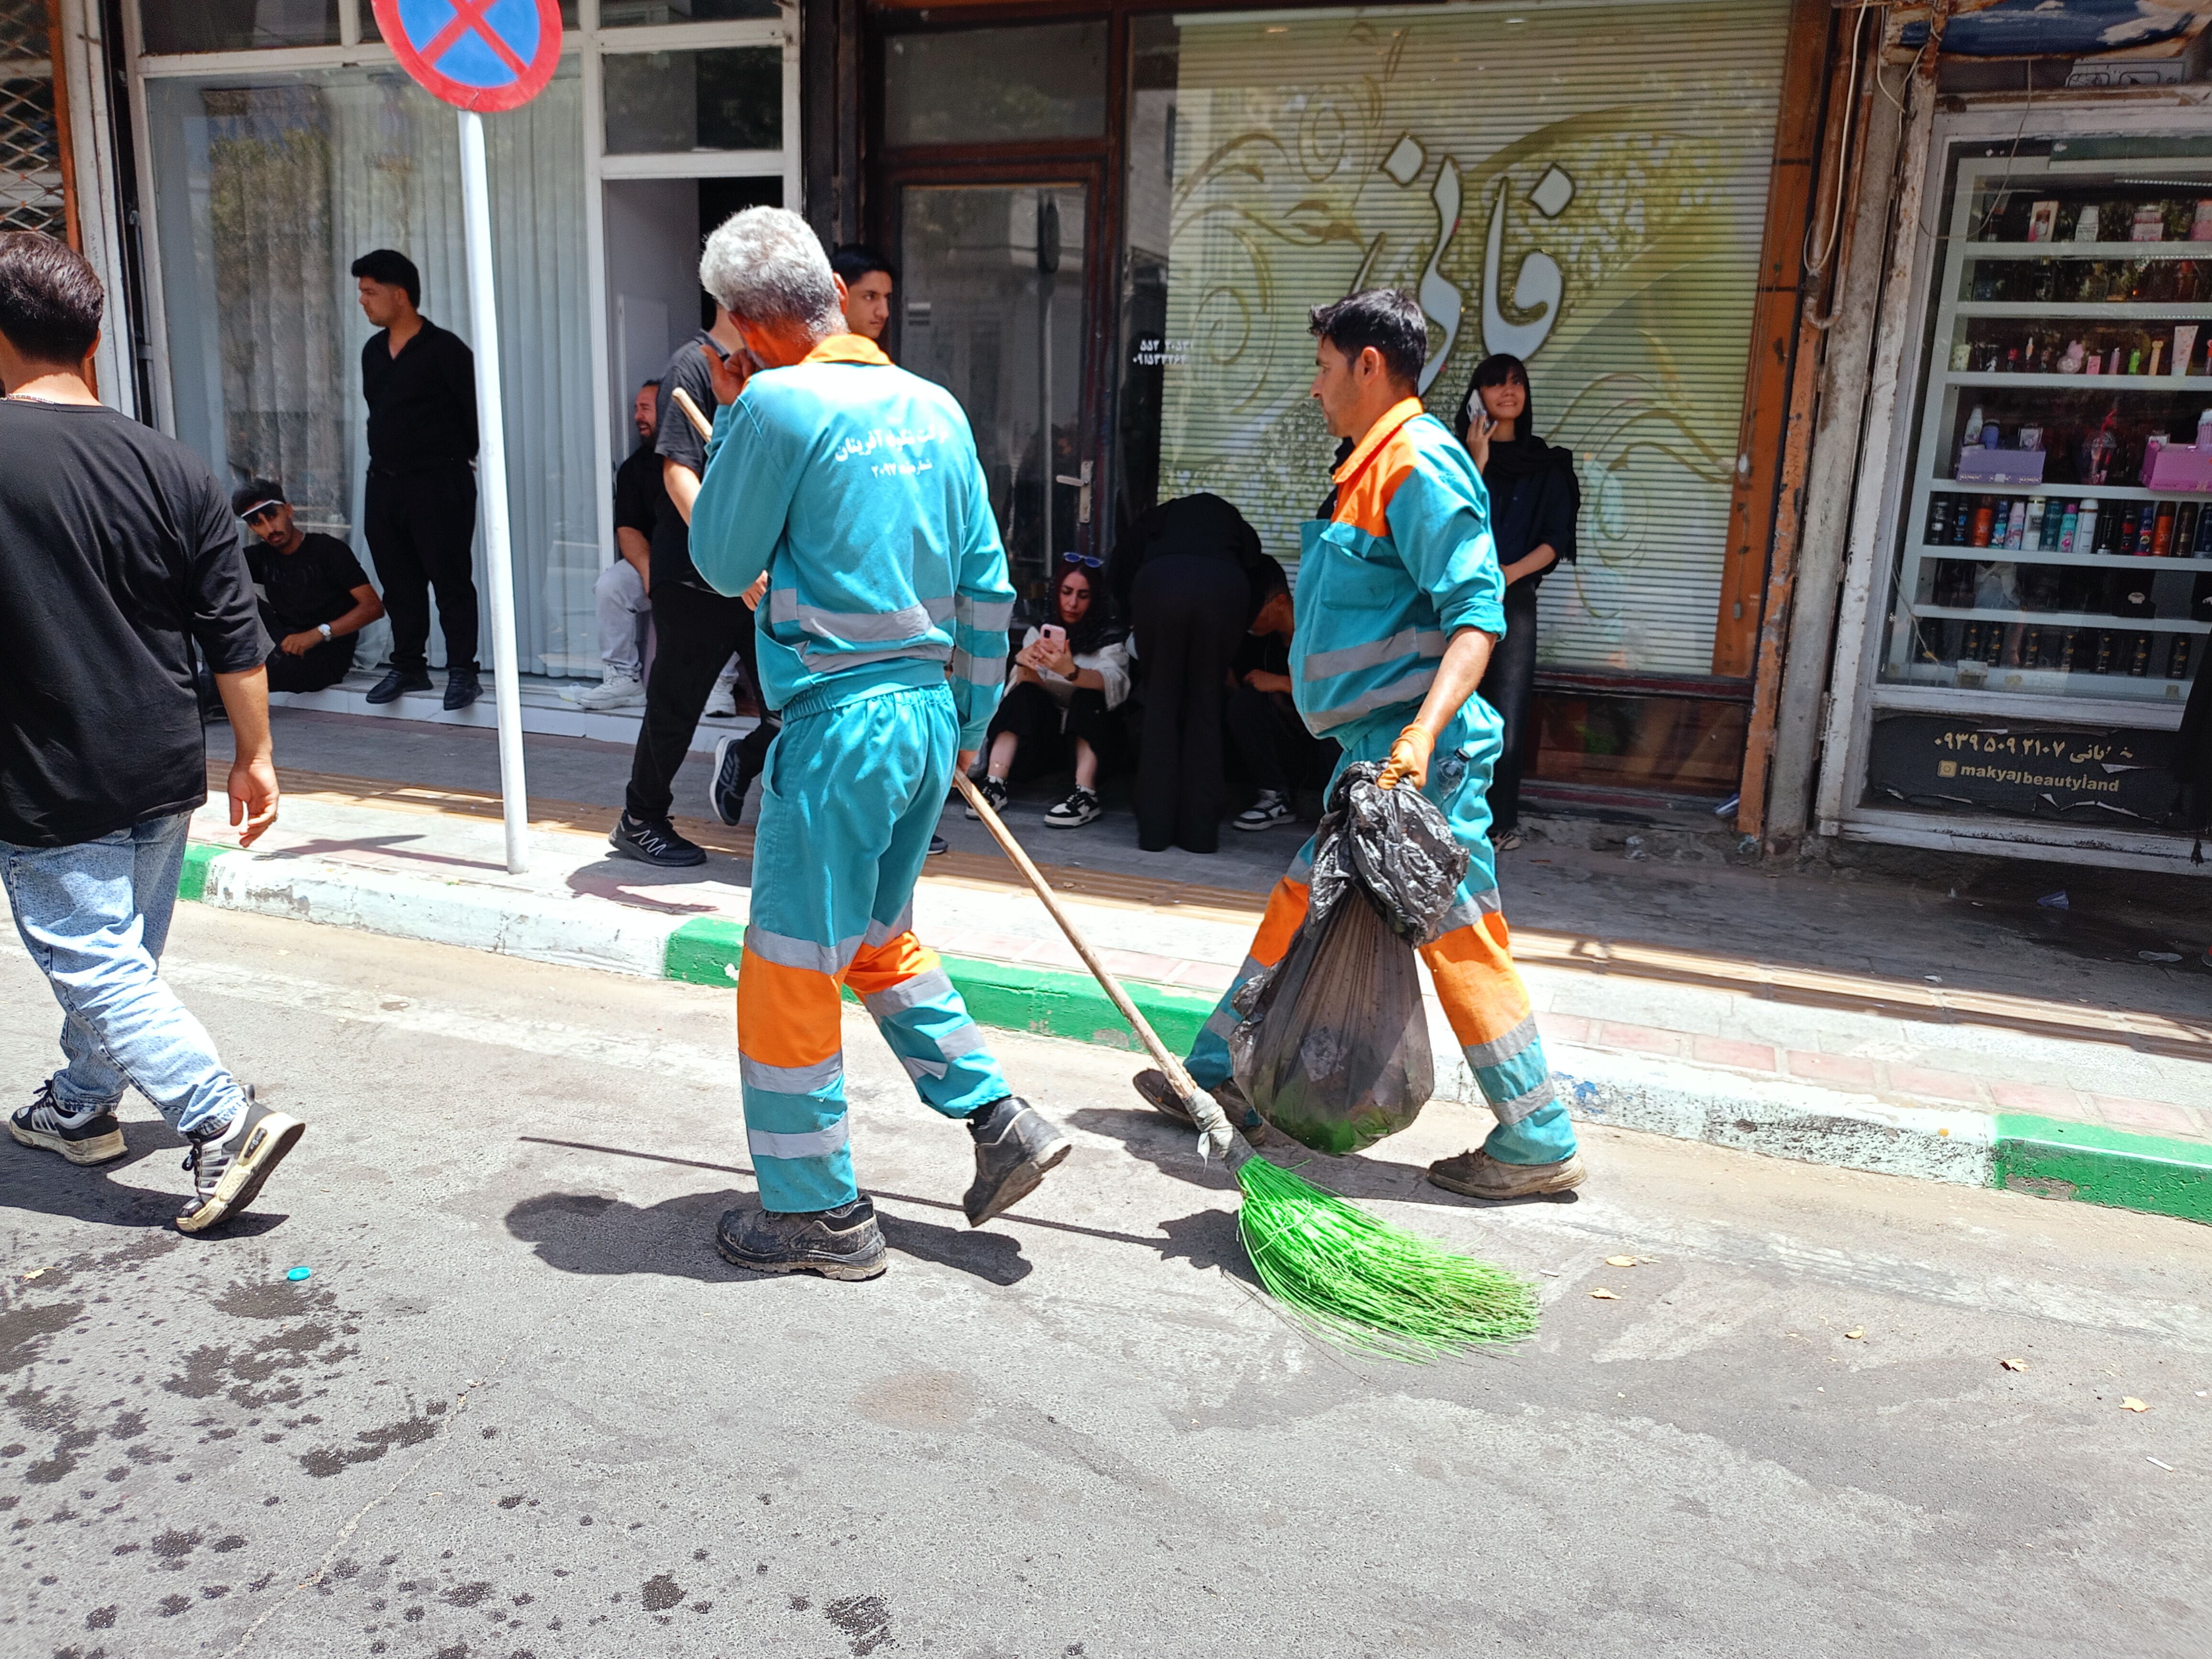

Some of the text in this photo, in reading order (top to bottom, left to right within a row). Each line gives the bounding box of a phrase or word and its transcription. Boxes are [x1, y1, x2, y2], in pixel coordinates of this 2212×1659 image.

[835, 428, 883, 462] آفرینان
[1934, 731, 1979, 752] ۰۹۳۹
[1983, 736, 2016, 754] ۵۰۹
[2022, 738, 2066, 757] ۲۱۰۷
